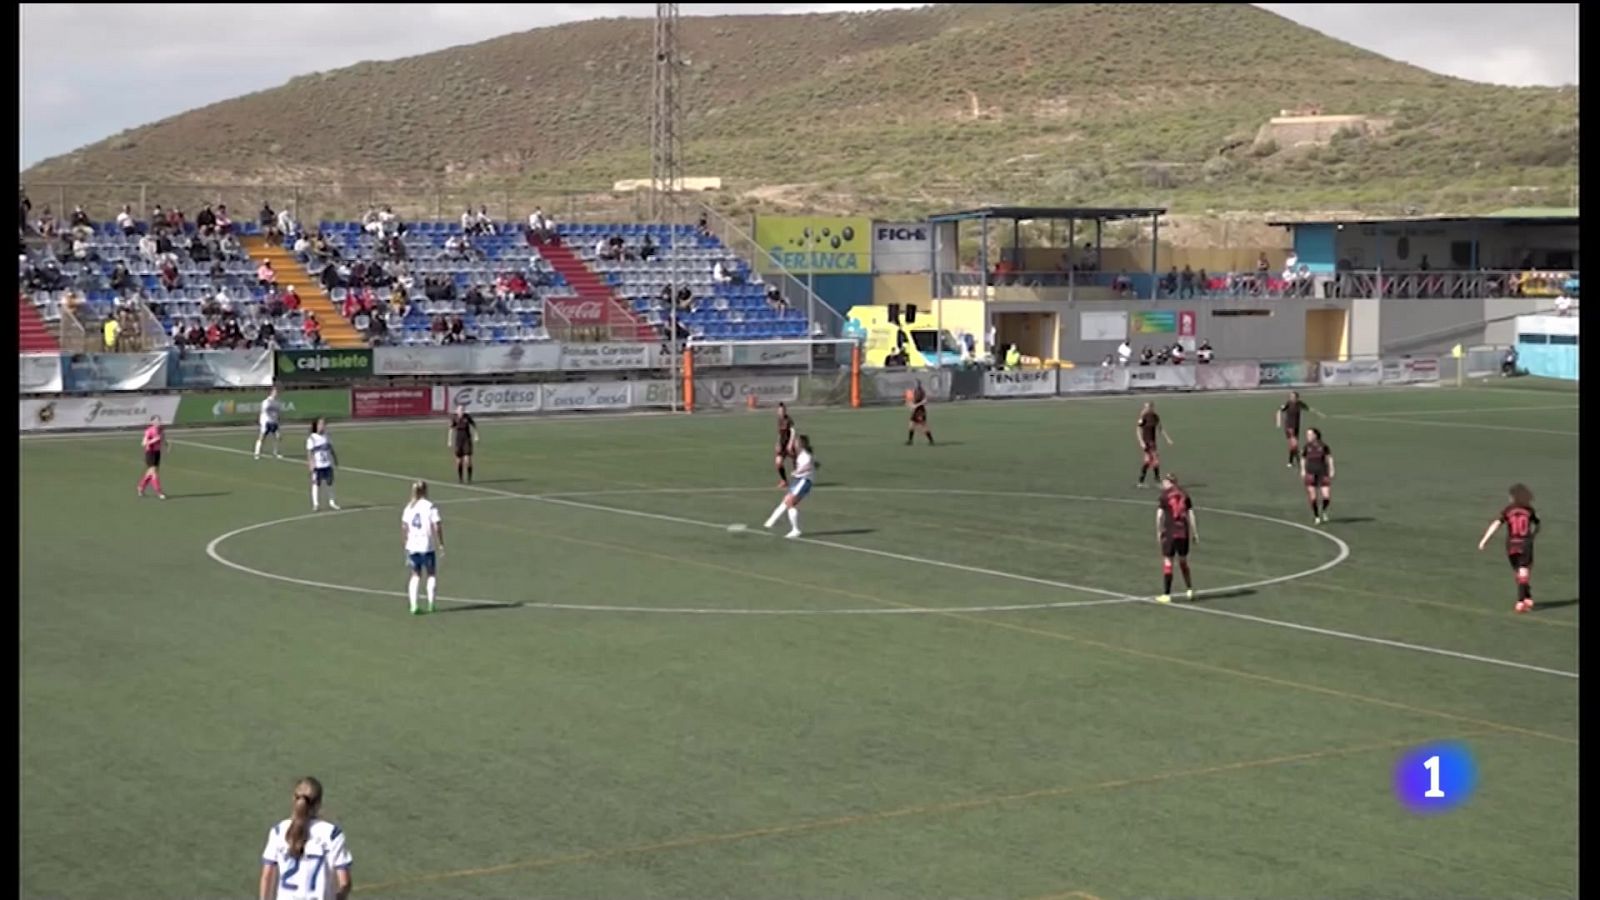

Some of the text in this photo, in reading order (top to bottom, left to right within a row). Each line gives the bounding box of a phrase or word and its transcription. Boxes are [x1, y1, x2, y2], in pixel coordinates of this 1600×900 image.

[297, 354, 369, 371] cajasiete
[412, 513, 422, 529] 4
[282, 853, 328, 891] 27
